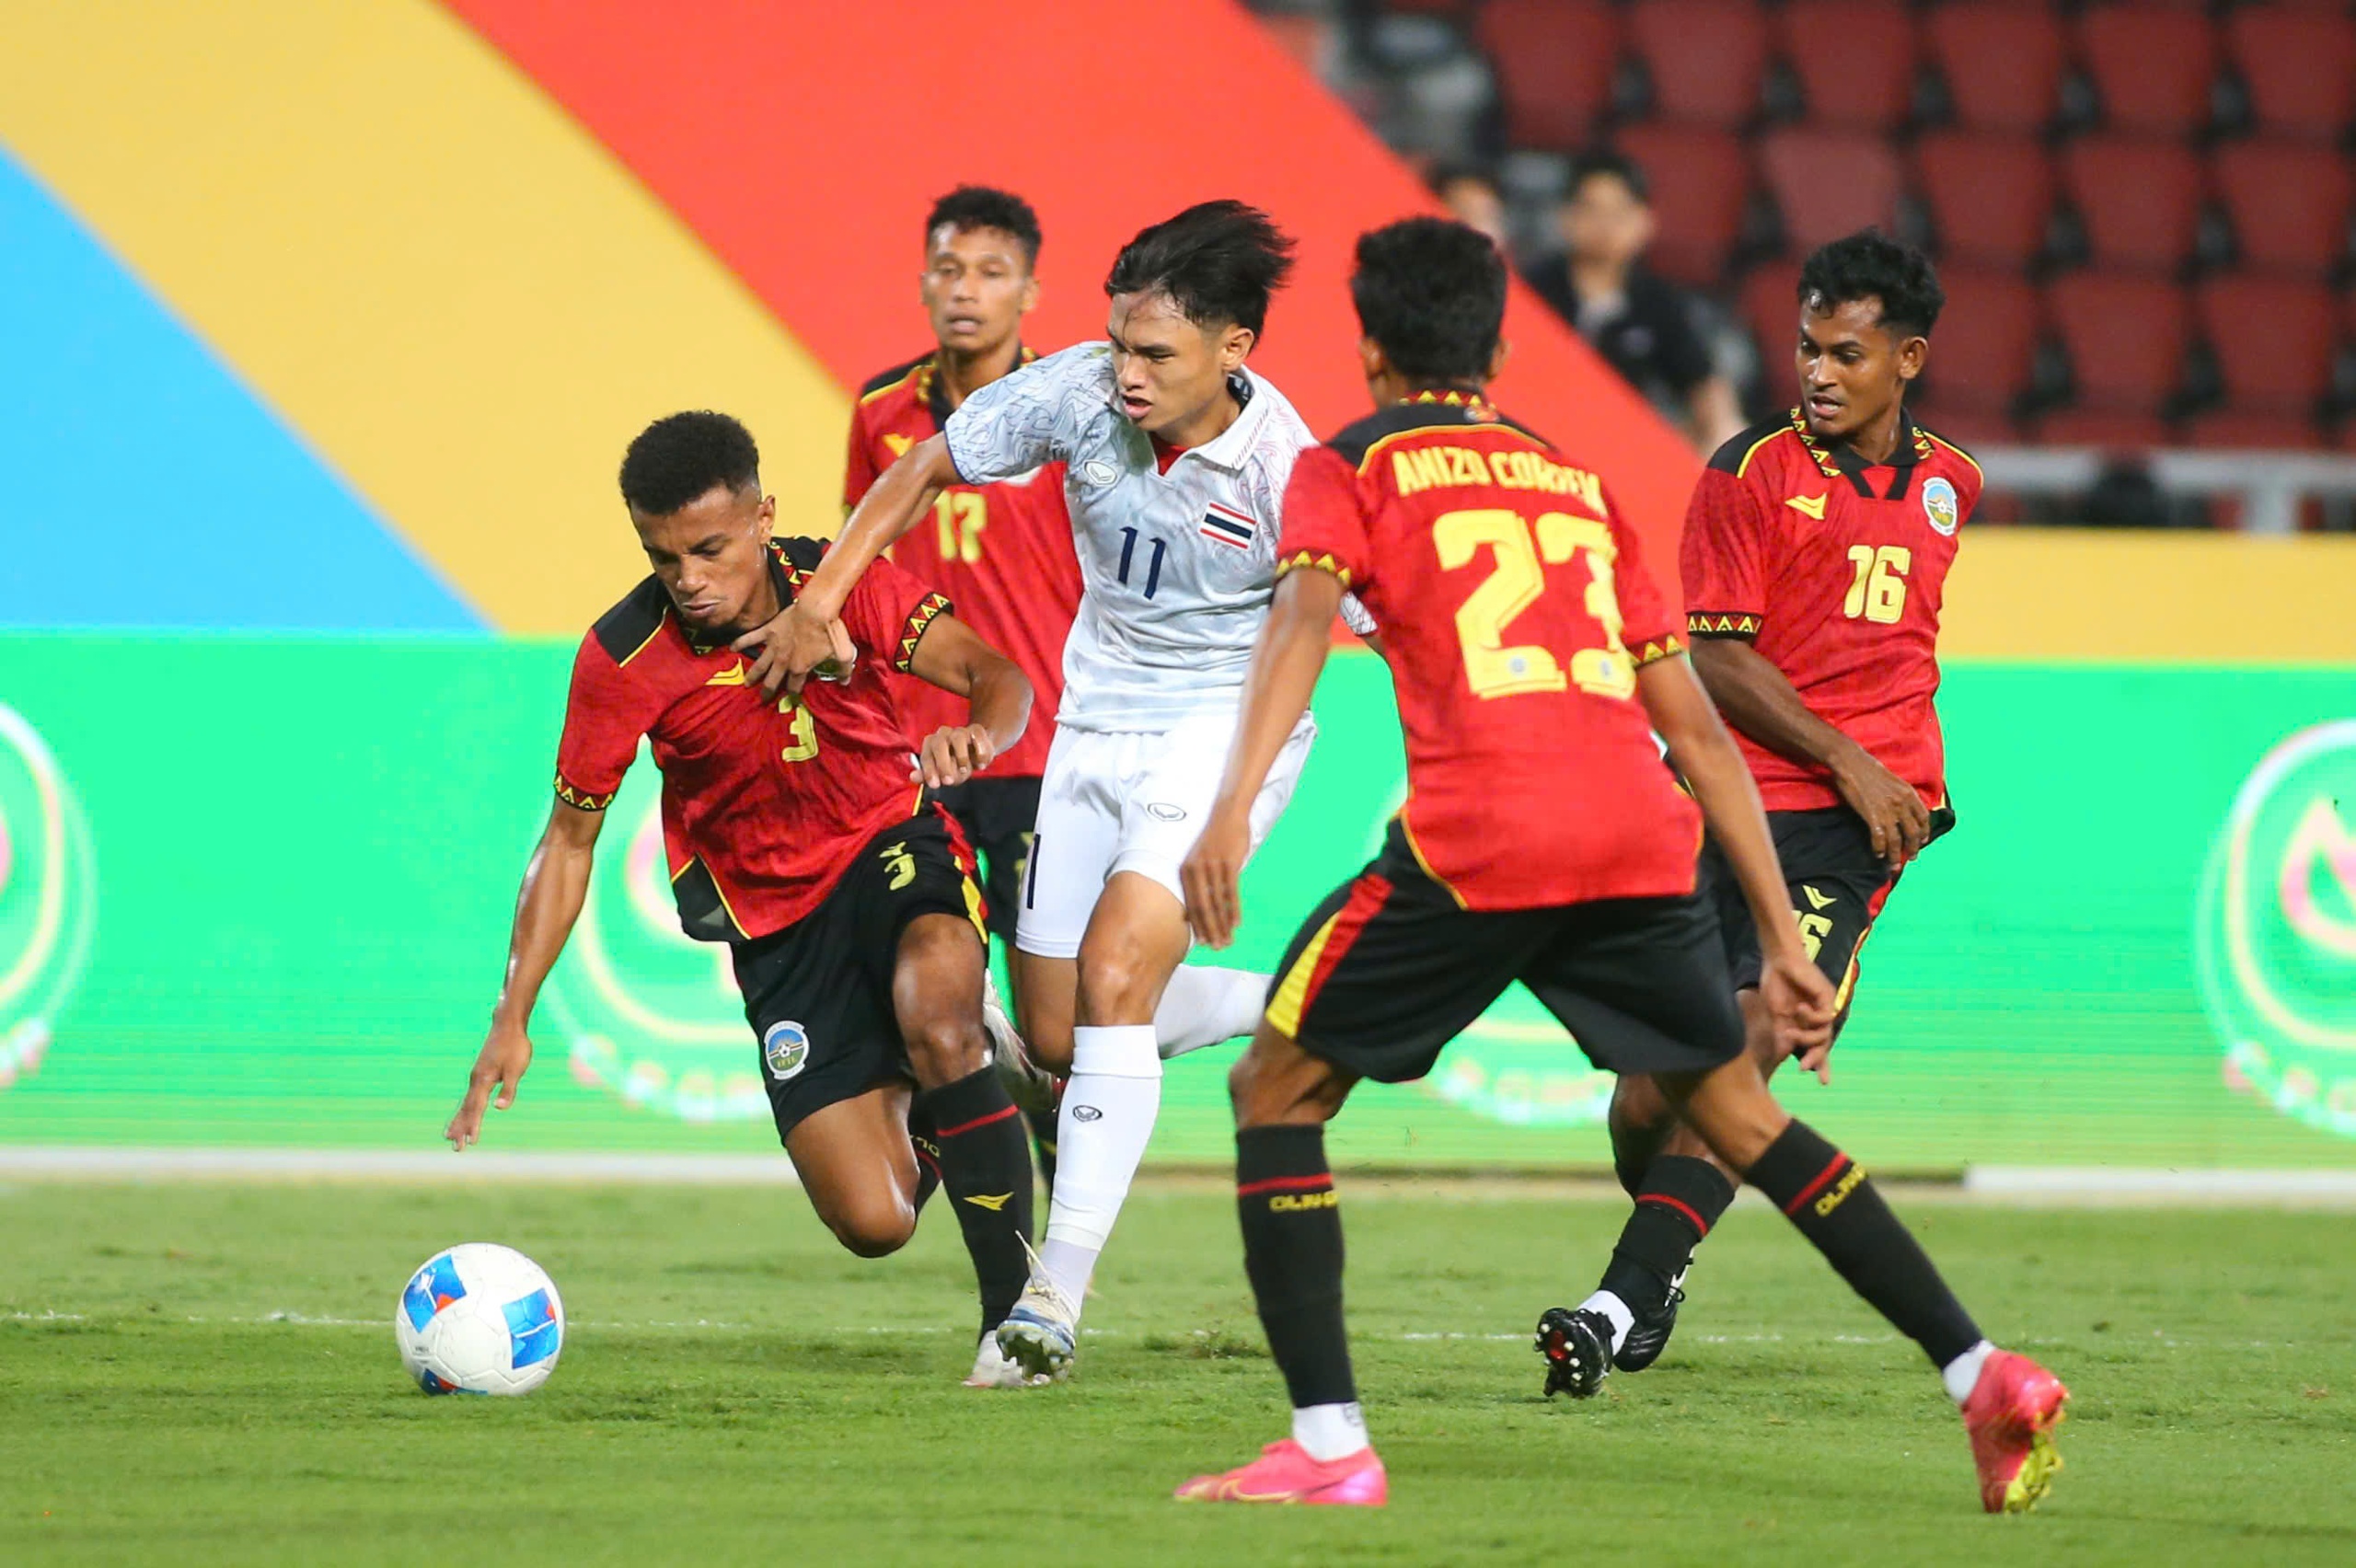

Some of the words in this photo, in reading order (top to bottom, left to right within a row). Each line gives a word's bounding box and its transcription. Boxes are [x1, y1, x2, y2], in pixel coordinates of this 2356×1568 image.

[1392, 445, 1492, 497] ANIZO
[1117, 525, 1167, 601] 11
[1842, 544, 1911, 625] 16
[1431, 508, 1637, 702] 23
[778, 695, 819, 763] 3
[884, 853, 917, 891] 3
